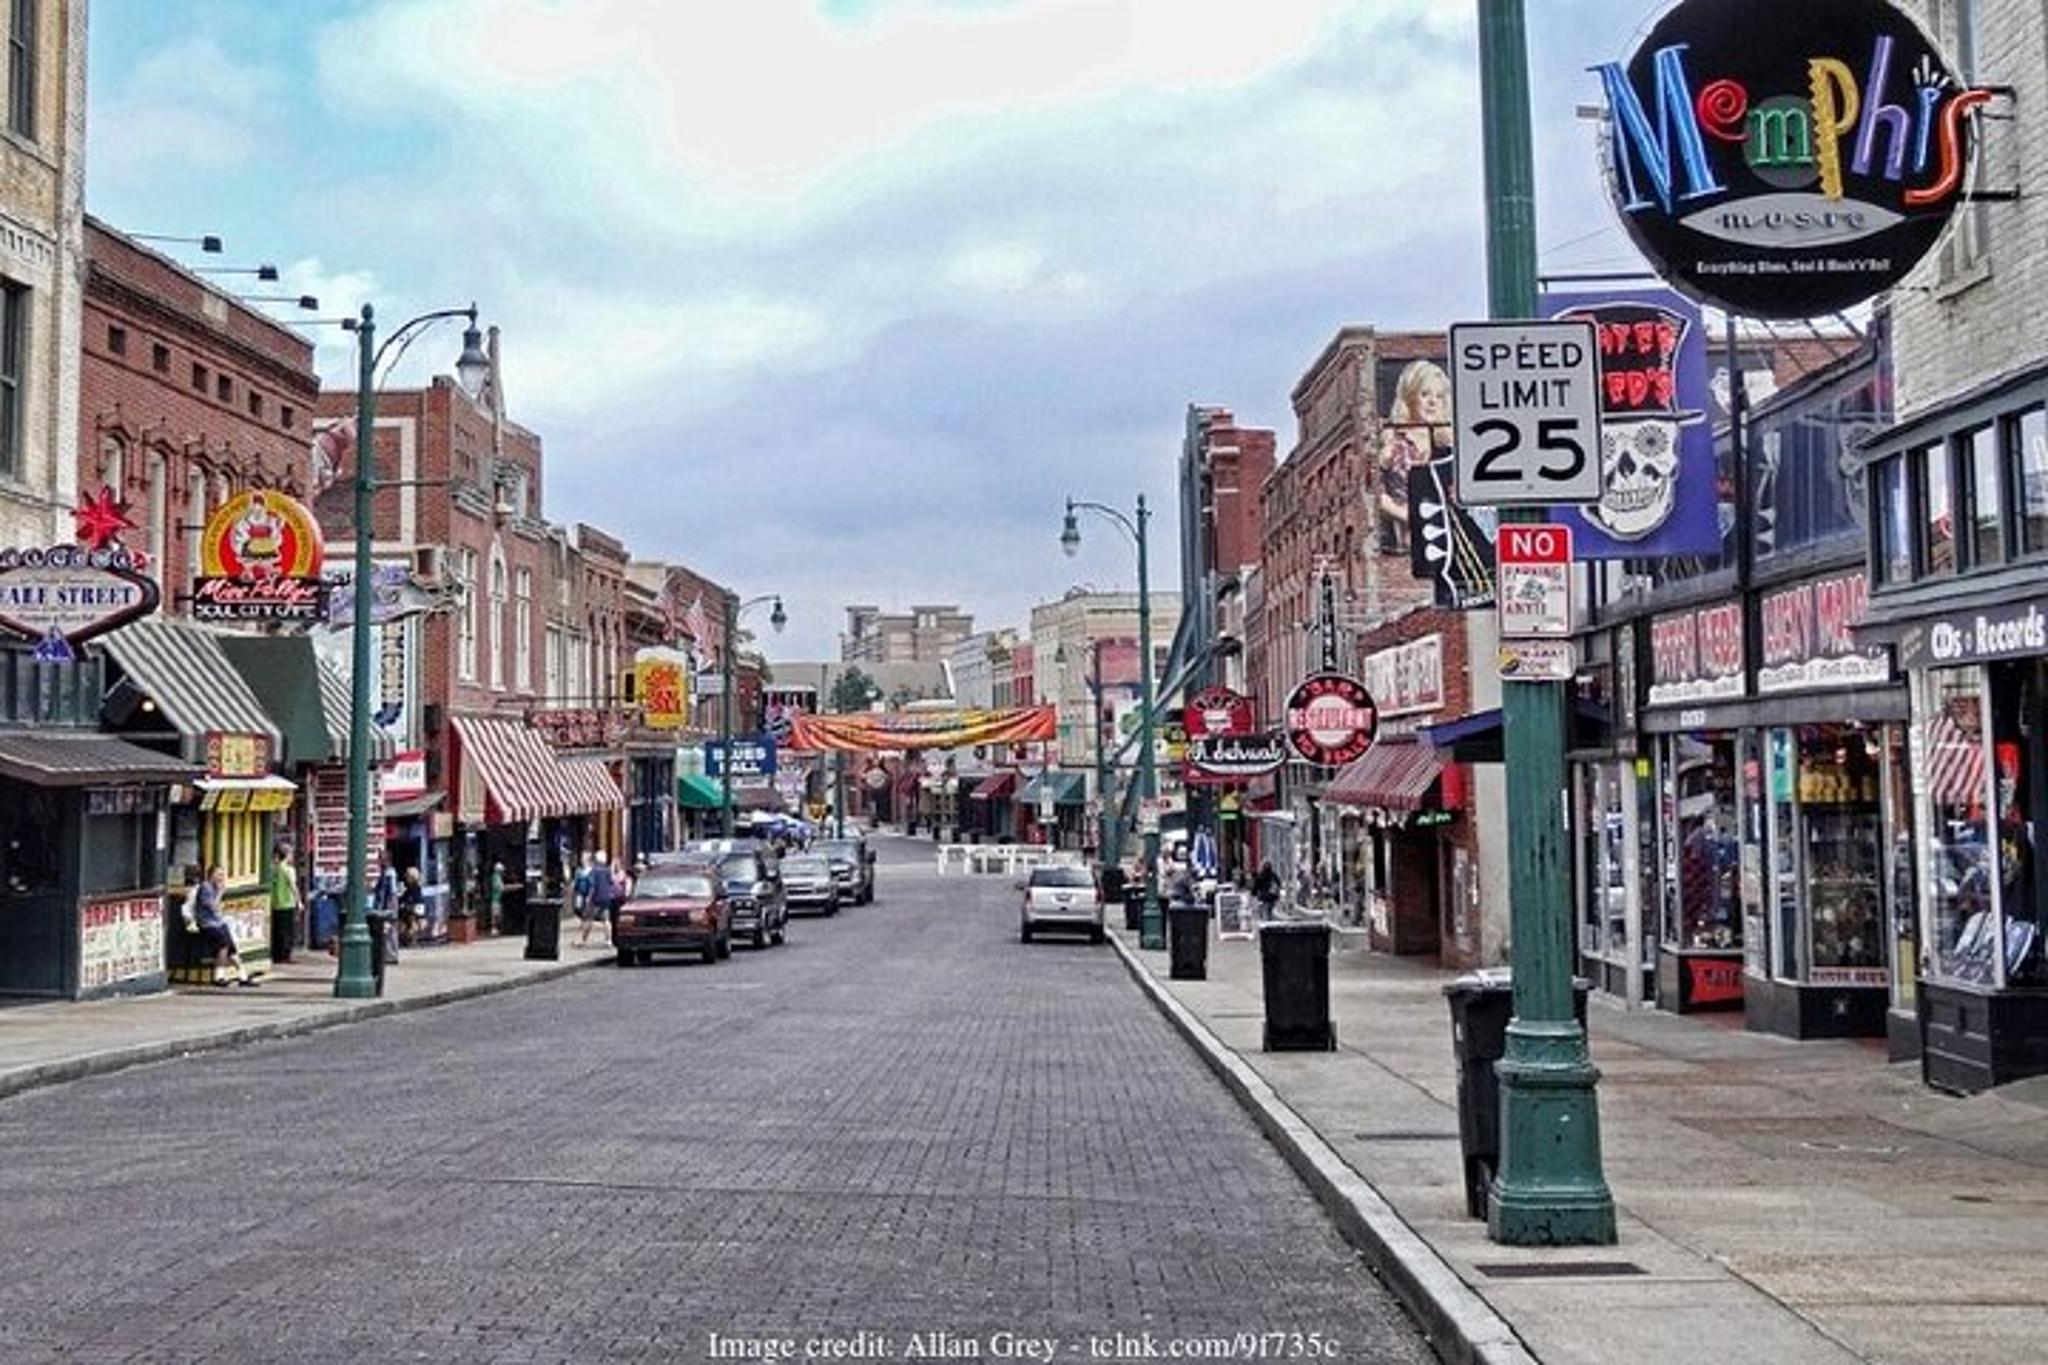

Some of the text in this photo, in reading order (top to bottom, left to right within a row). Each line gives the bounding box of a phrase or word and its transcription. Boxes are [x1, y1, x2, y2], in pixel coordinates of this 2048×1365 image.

[1585, 35, 1992, 214] Memphis
[1697, 261, 1755, 275] Everything
[1464, 343, 1583, 370] SPEED
[1481, 380, 1571, 409] LIMIT
[1472, 419, 1585, 482] 25
[1511, 530, 1555, 557] NO
[57, 586, 135, 604] STREET
[1931, 622, 1962, 659] CDs
[1975, 604, 2045, 655] Records
[713, 747, 766, 760] BUES
